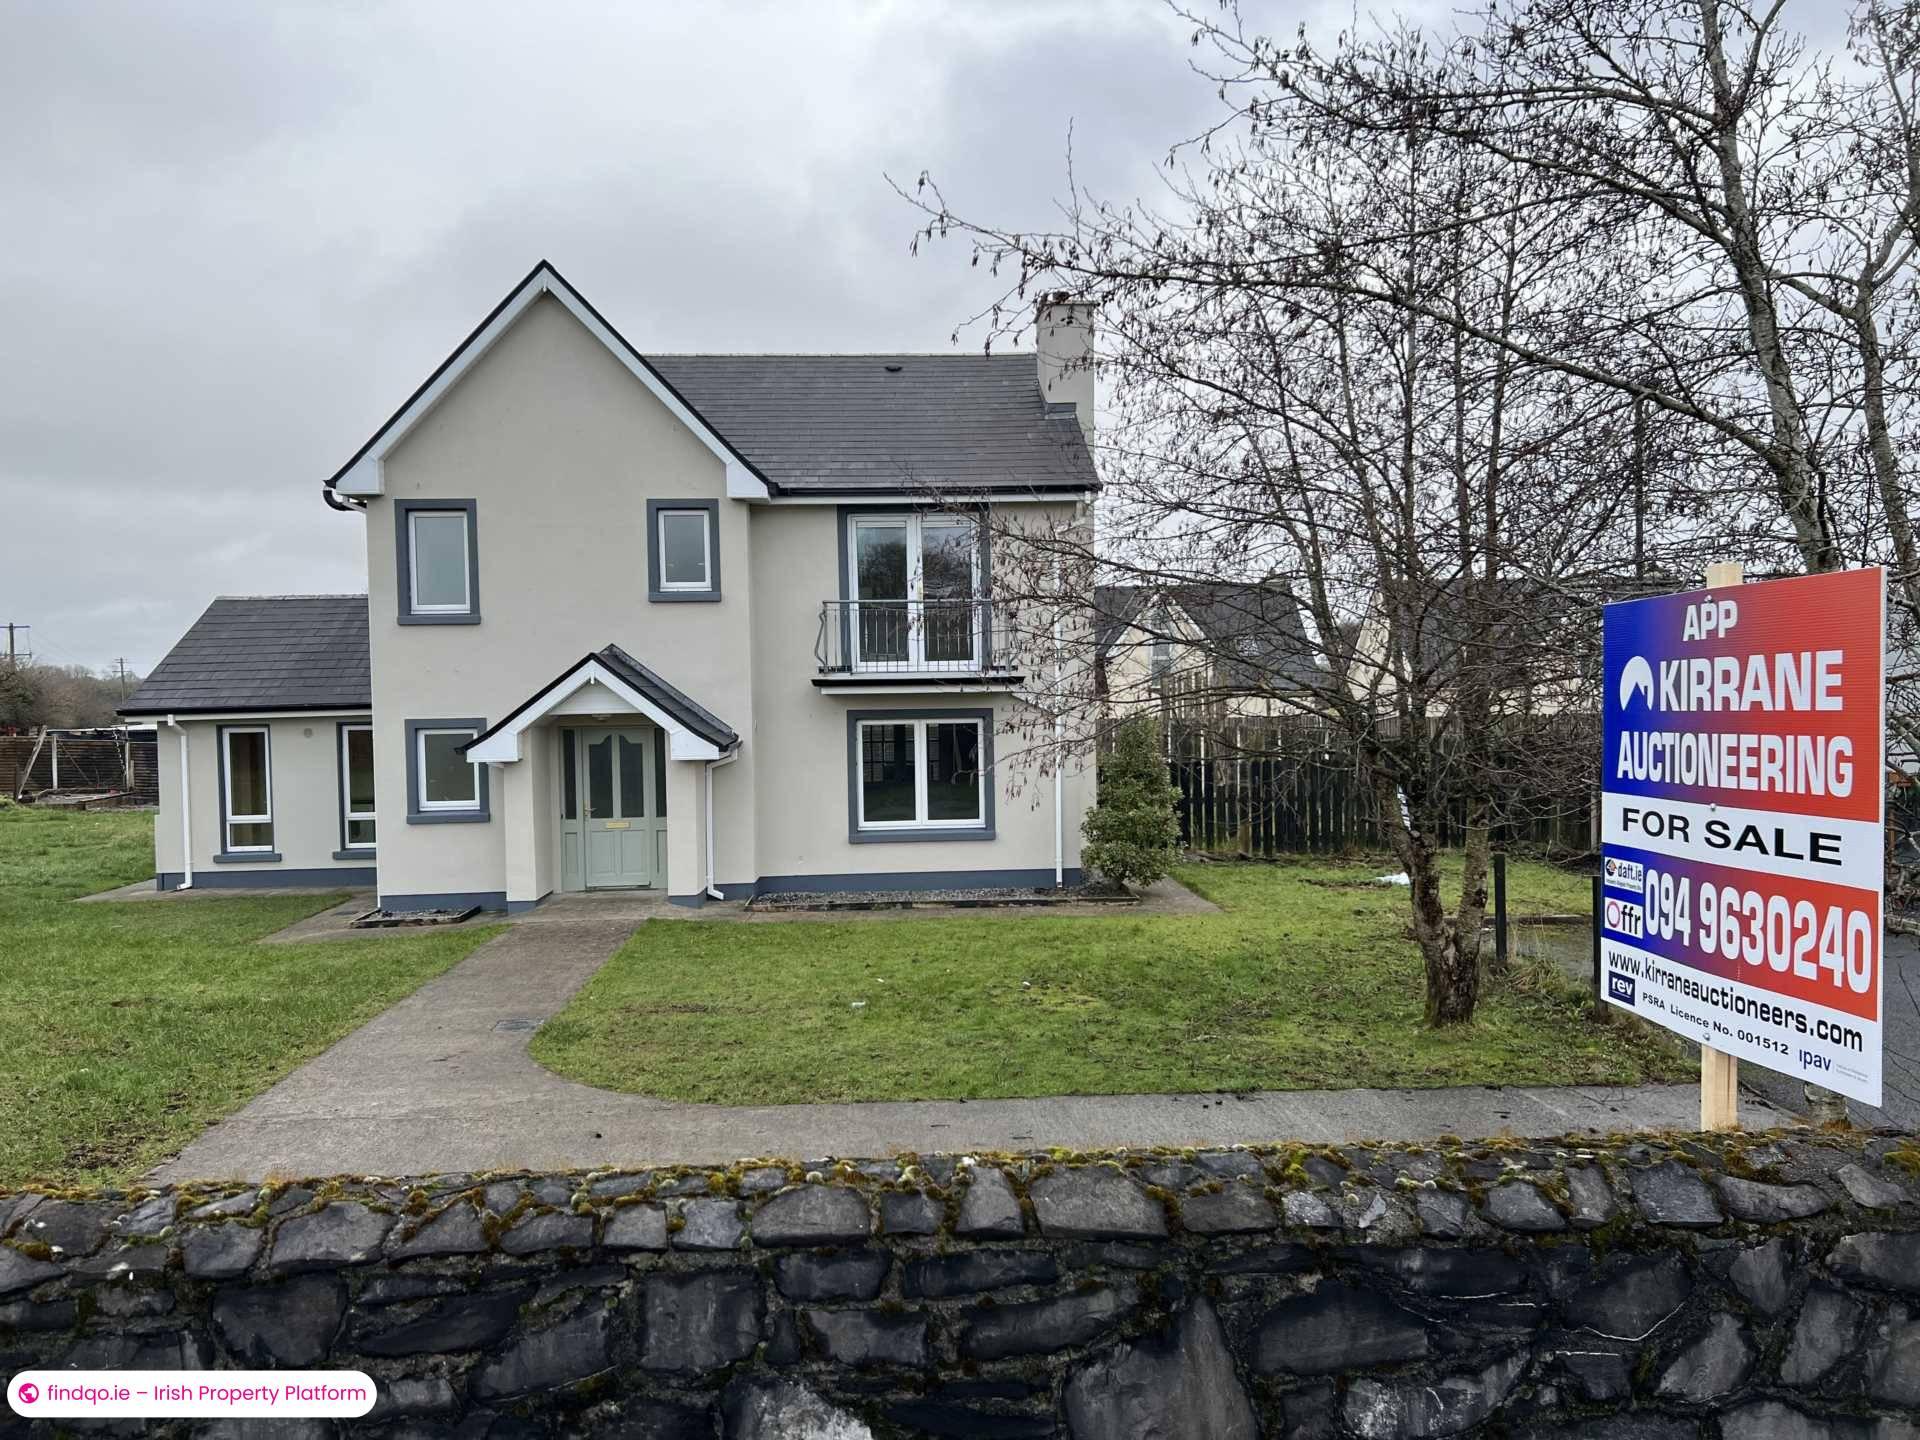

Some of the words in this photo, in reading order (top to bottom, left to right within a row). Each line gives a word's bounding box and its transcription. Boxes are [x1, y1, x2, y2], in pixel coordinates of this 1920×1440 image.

[1682, 600, 1738, 641] APP
[1659, 650, 1843, 712] KIRRANE
[1616, 731, 1853, 798] AUCTIONEERING
[1622, 807, 1690, 843] FOR
[1704, 820, 1842, 866] SALE
[1617, 862, 1642, 882] daft.ie
[1645, 869, 1691, 947] 094
[1699, 882, 1872, 994] 9630240
[1608, 951, 1863, 1052] www.kirraneauctioneers.com
[1611, 977, 1633, 995] rev
[1642, 992, 1665, 1010] PSRA
[1670, 1004, 1709, 1027] Licence
[1713, 1021, 1733, 1037] No.
[1737, 1030, 1789, 1055] 001512
